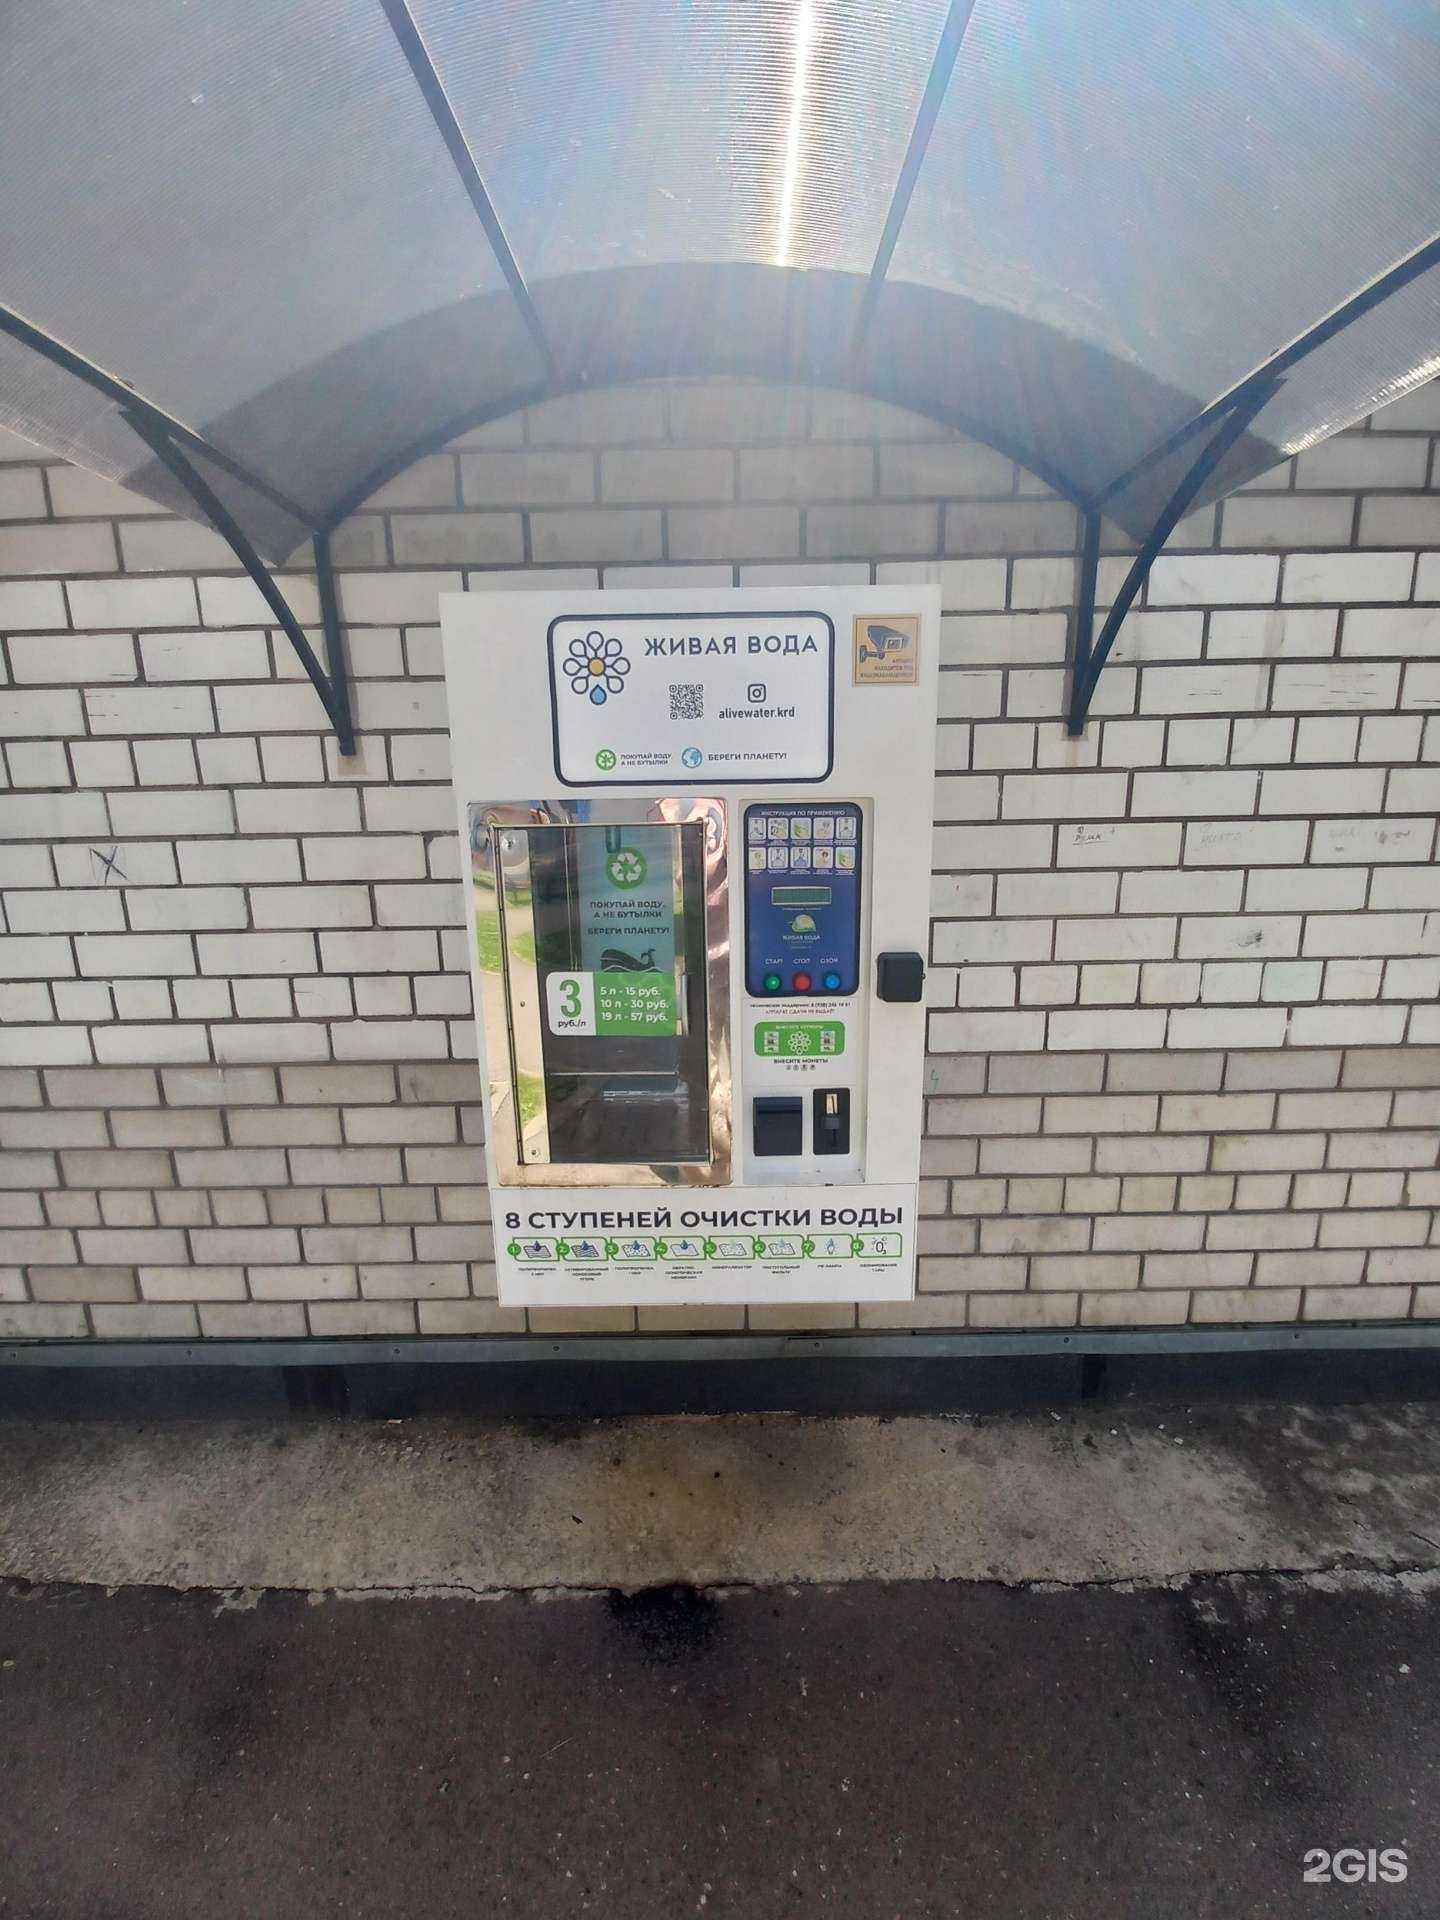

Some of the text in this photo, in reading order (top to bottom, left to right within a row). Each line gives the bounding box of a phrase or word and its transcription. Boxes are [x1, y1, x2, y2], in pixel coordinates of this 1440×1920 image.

[645, 635, 818, 656] ЖИВАЯ ВОДА
[718, 706, 795, 719] alivewater.krd
[621, 752, 652, 760] ПОКУПАЙ
[590, 899, 635, 908] ПОКУПАЙ
[588, 927, 670, 935] БЕРЕГИ ПЛАНЕТУ!
[600, 987, 607, 995] 5
[625, 987, 635, 995] 15
[638, 987, 661, 997] руб.
[560, 979, 582, 1018] 3
[601, 1000, 612, 1008] 10
[631, 1000, 644, 1008] 30
[646, 1000, 669, 1010] руб.
[601, 1012, 612, 1020] 19
[631, 1013, 642, 1021] 57
[646, 1012, 668, 1023] руб.
[558, 1020, 586, 1028] руб./л
[505, 1207, 902, 1229] 8 СТУПЕНЕЙ ОЧИСТКИ ВОДЫ
